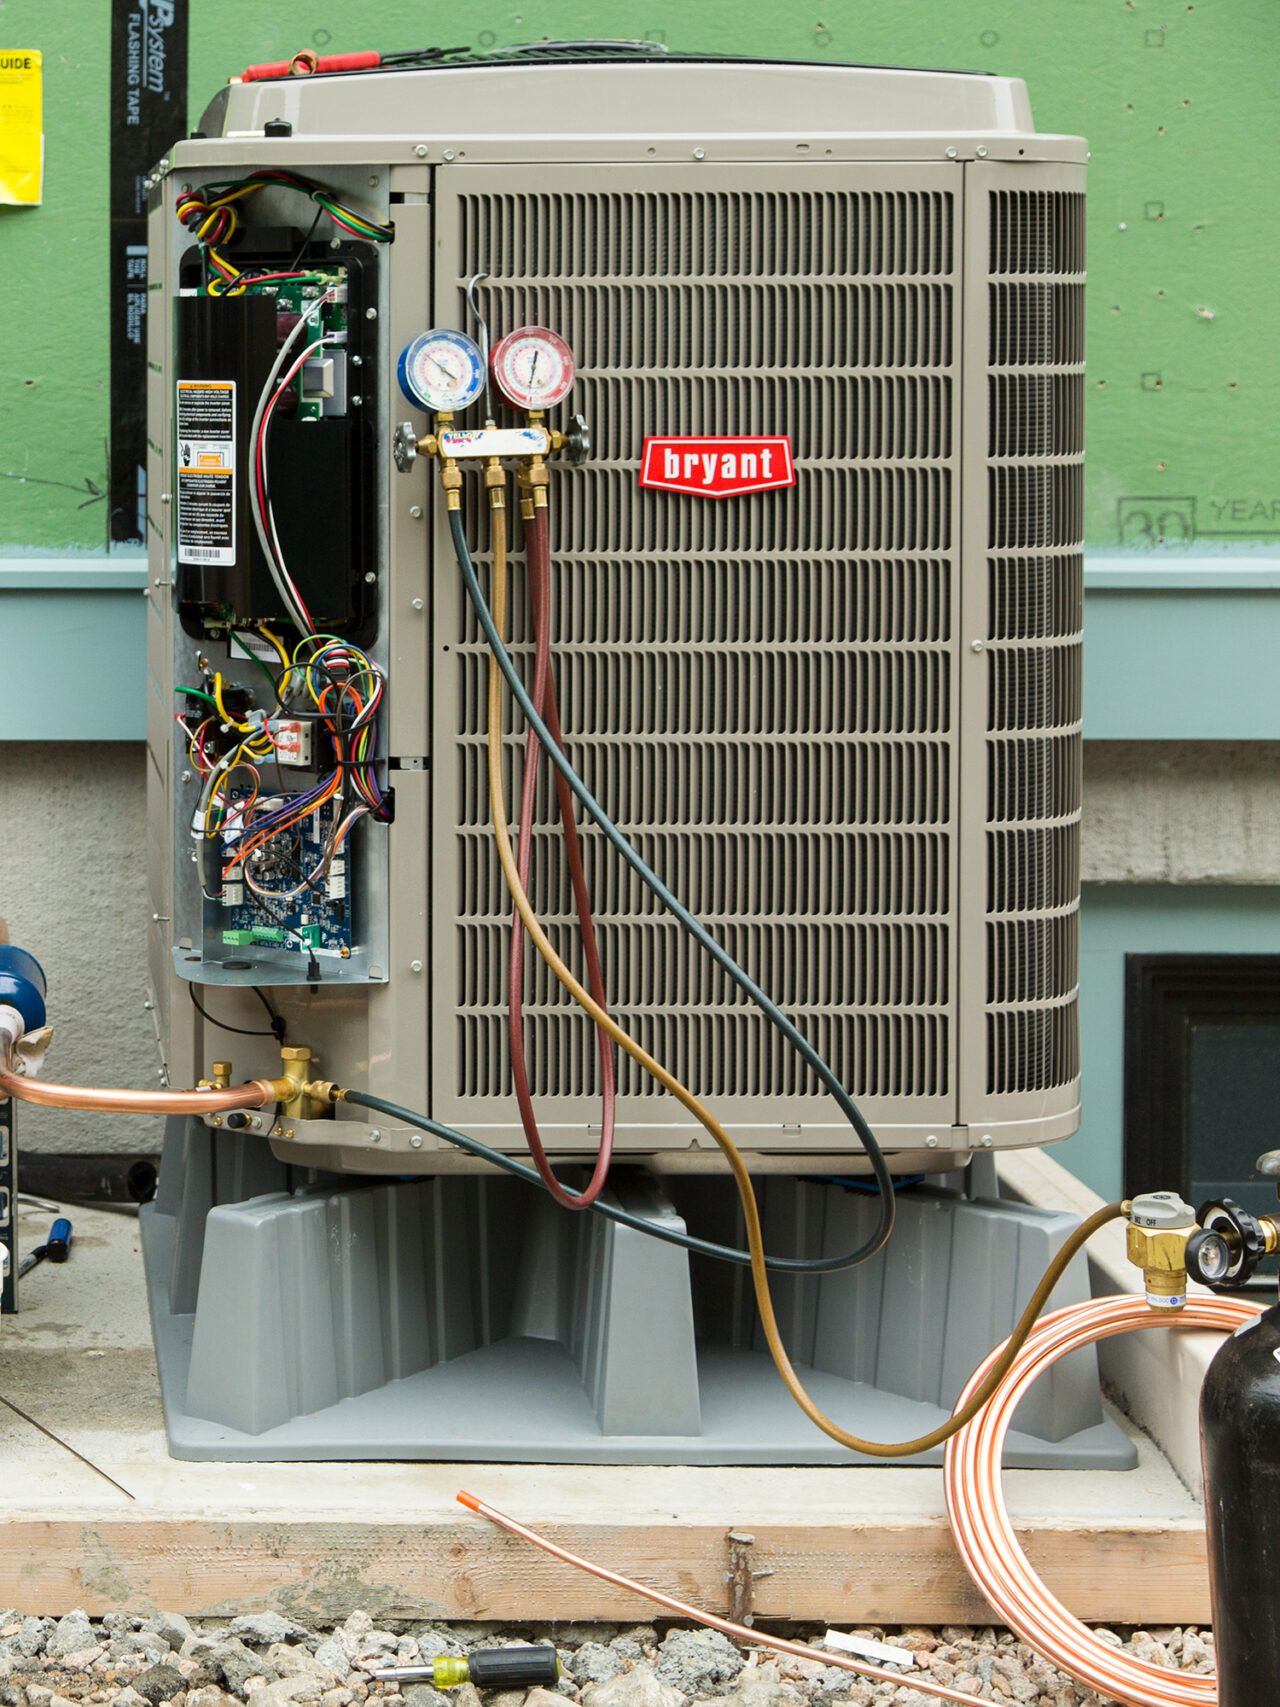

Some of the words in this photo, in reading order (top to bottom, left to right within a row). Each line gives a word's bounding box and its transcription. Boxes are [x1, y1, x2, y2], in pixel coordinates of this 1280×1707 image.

[126, 12, 140, 85] FLASHING
[126, 88, 140, 125] TAPE
[663, 448, 773, 485] bryant
